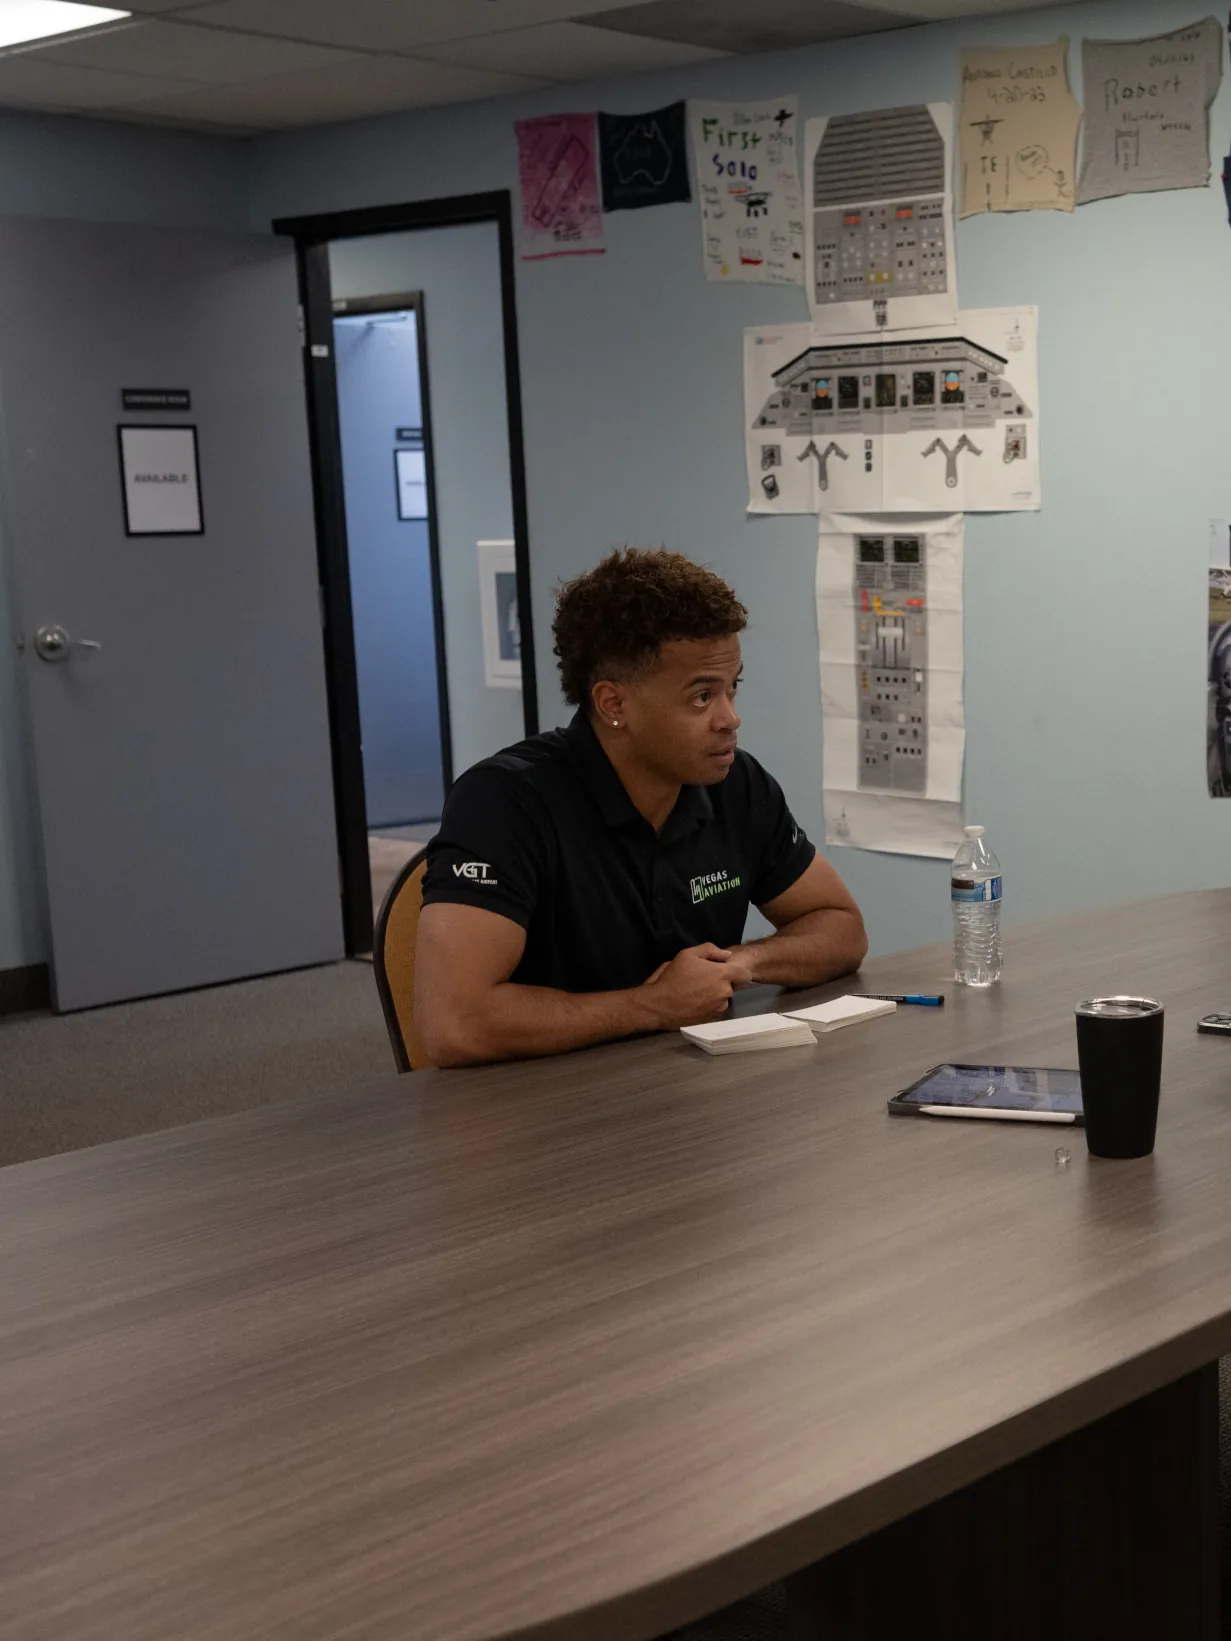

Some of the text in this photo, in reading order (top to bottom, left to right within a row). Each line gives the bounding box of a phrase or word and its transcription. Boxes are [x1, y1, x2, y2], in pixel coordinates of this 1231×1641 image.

[1104, 75, 1181, 113] Robert
[701, 118, 762, 151] First
[711, 154, 757, 181] Solo
[134, 474, 188, 484] AVAILABLE
[452, 862, 492, 879] VGT
[702, 869, 728, 886] VEGAS
[704, 876, 741, 898] AVIATION
